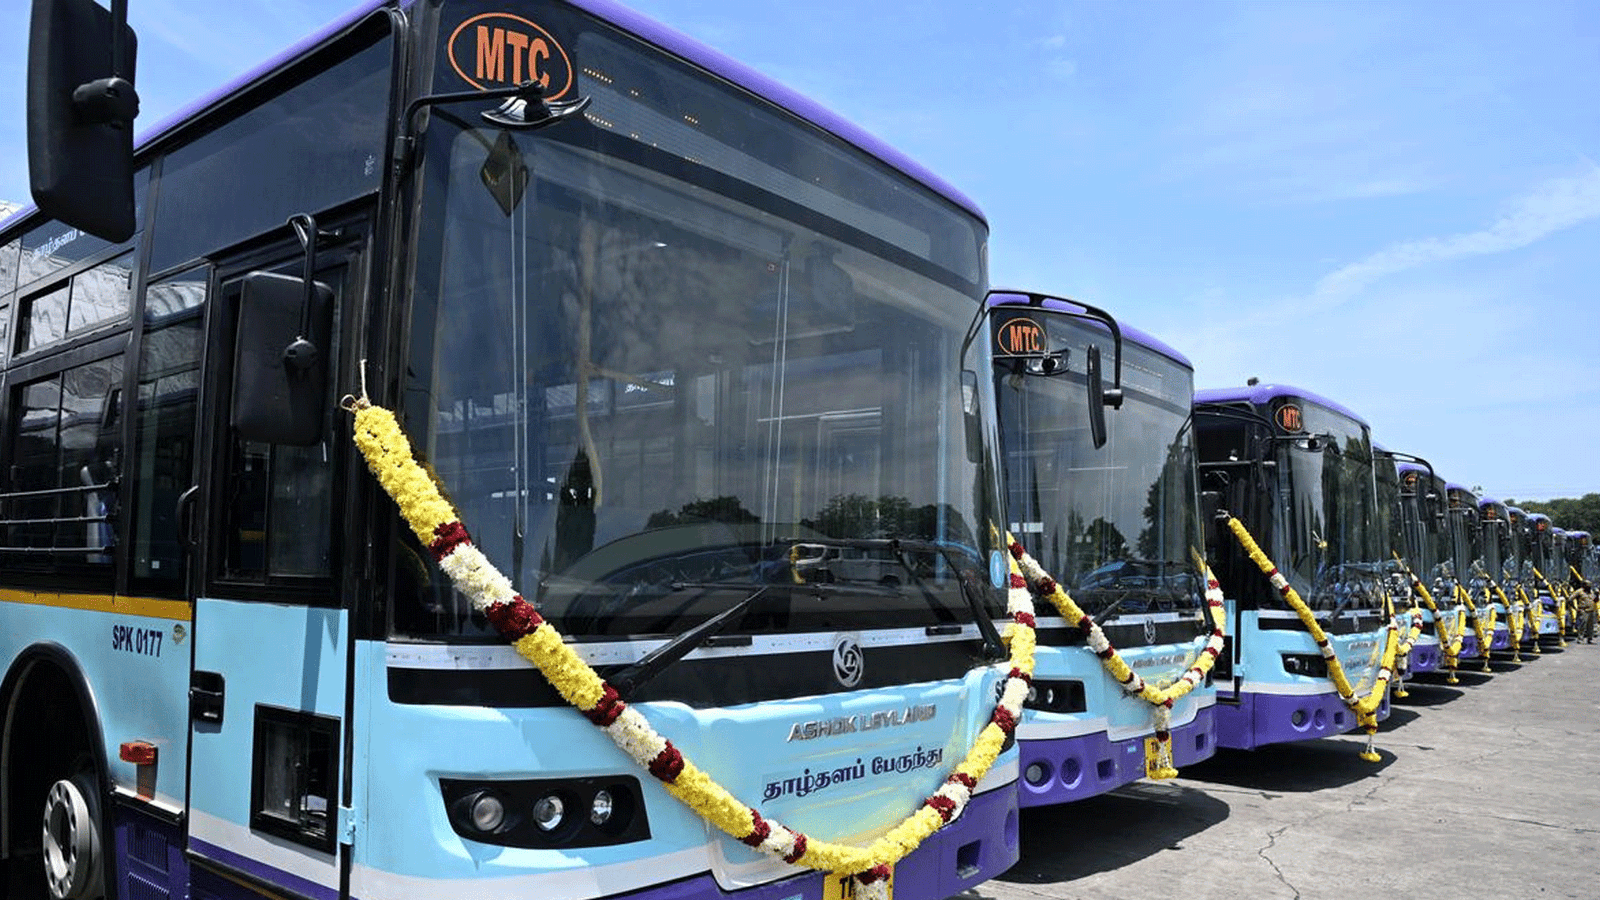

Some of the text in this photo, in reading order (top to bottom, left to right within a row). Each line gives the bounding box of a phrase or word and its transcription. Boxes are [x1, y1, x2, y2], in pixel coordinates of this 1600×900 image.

[477, 25, 550, 89] MTC
[1010, 325, 1040, 352] MTC
[1283, 407, 1301, 429] MTC
[113, 625, 163, 657] SPK 0177
[787, 703, 936, 743] ASHOK LEYLAND
[761, 746, 943, 805] தாழ்தளப் பேருந்து
